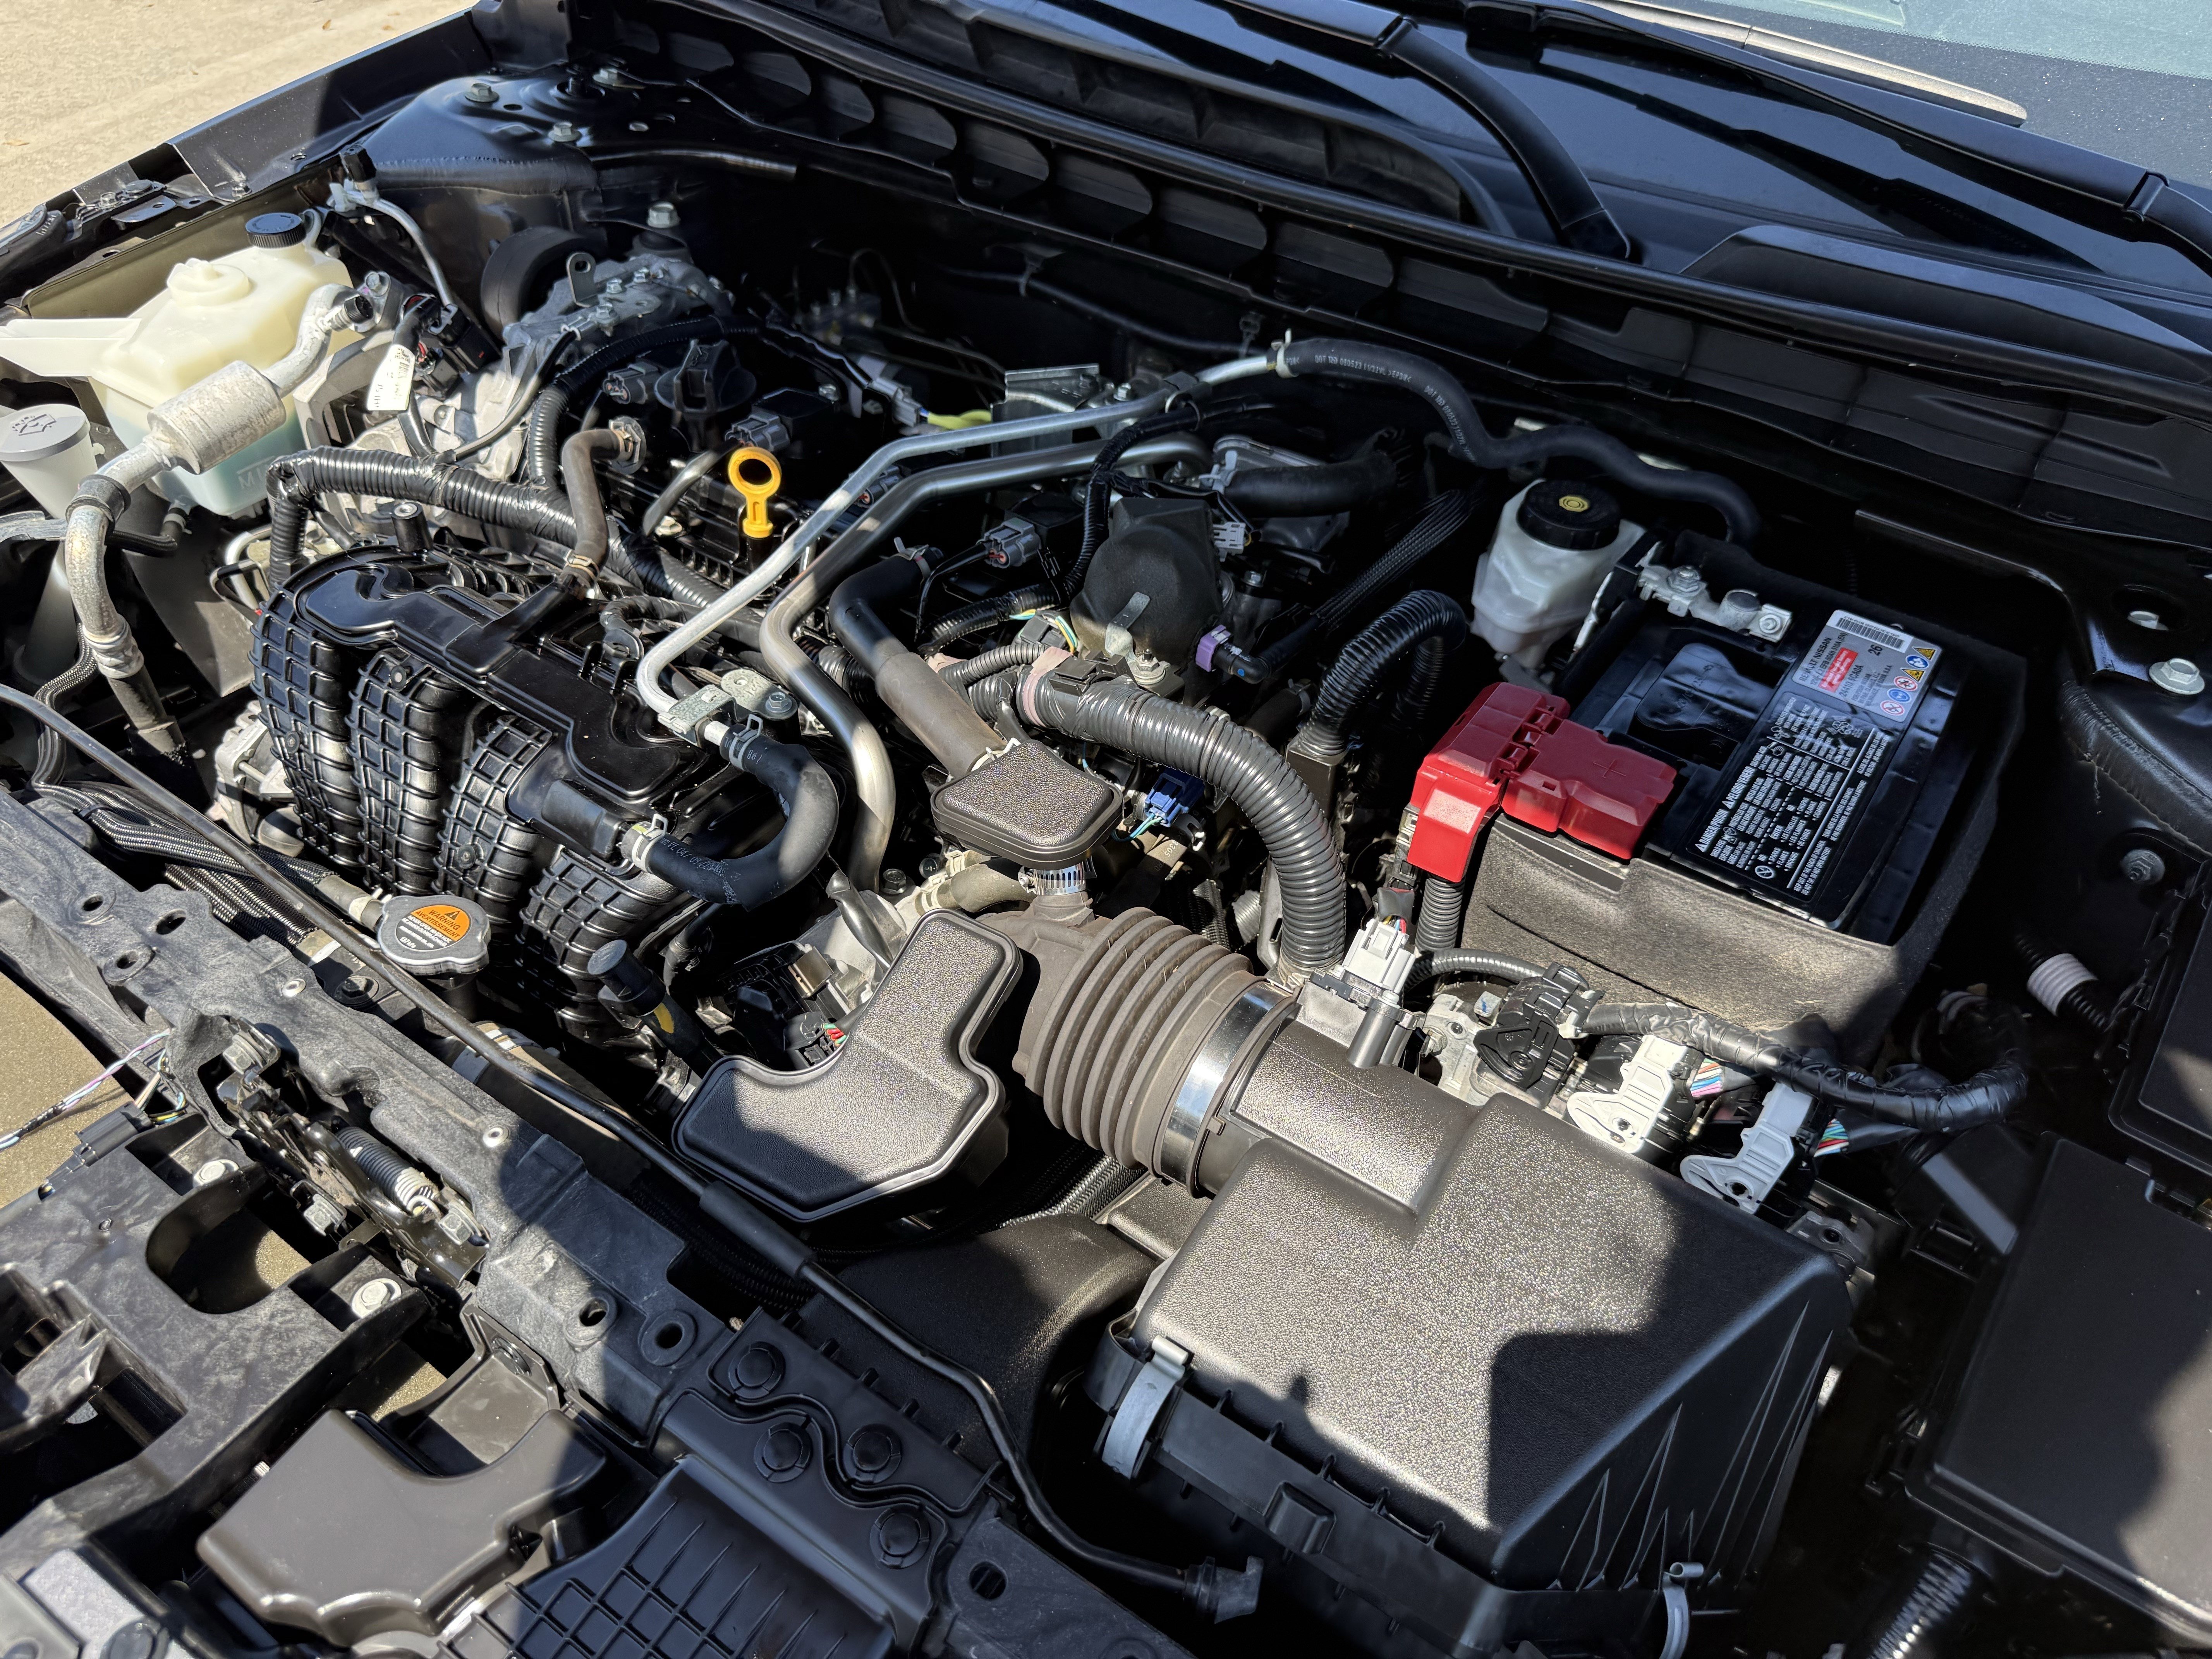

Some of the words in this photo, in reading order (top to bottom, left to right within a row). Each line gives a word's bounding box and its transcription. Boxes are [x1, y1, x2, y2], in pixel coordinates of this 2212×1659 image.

[1819, 660, 1829, 669] EFB
[1824, 649, 1836, 661] 60Ah
[1831, 640, 1841, 651] 510A
[1836, 632, 1848, 642] (EN)
[1867, 643, 1883, 656] 26
[1798, 658, 1818, 682] RENAULT
[1813, 636, 1832, 658] NISSAN
[1838, 681, 1853, 697] 24410
[1698, 808, 1728, 845] DANGER/POISON
[1726, 765, 1755, 802] PELIGRO/VENENO
[1796, 797, 1809, 812] CHISPAS
[1804, 800, 1817, 815] FLAMAS
[1792, 819, 1807, 837] FLAMMES
[1799, 828, 1812, 842] FUMER
[1718, 844, 1733, 861] EXPLOSIVE
[1768, 847, 1781, 862] SPARKS
[1776, 850, 1789, 865] FLAMES
[1784, 851, 1799, 869] SMOKING
[415, 910, 460, 939] AVERTISSEMENT
[428, 909, 461, 930] WARNING
